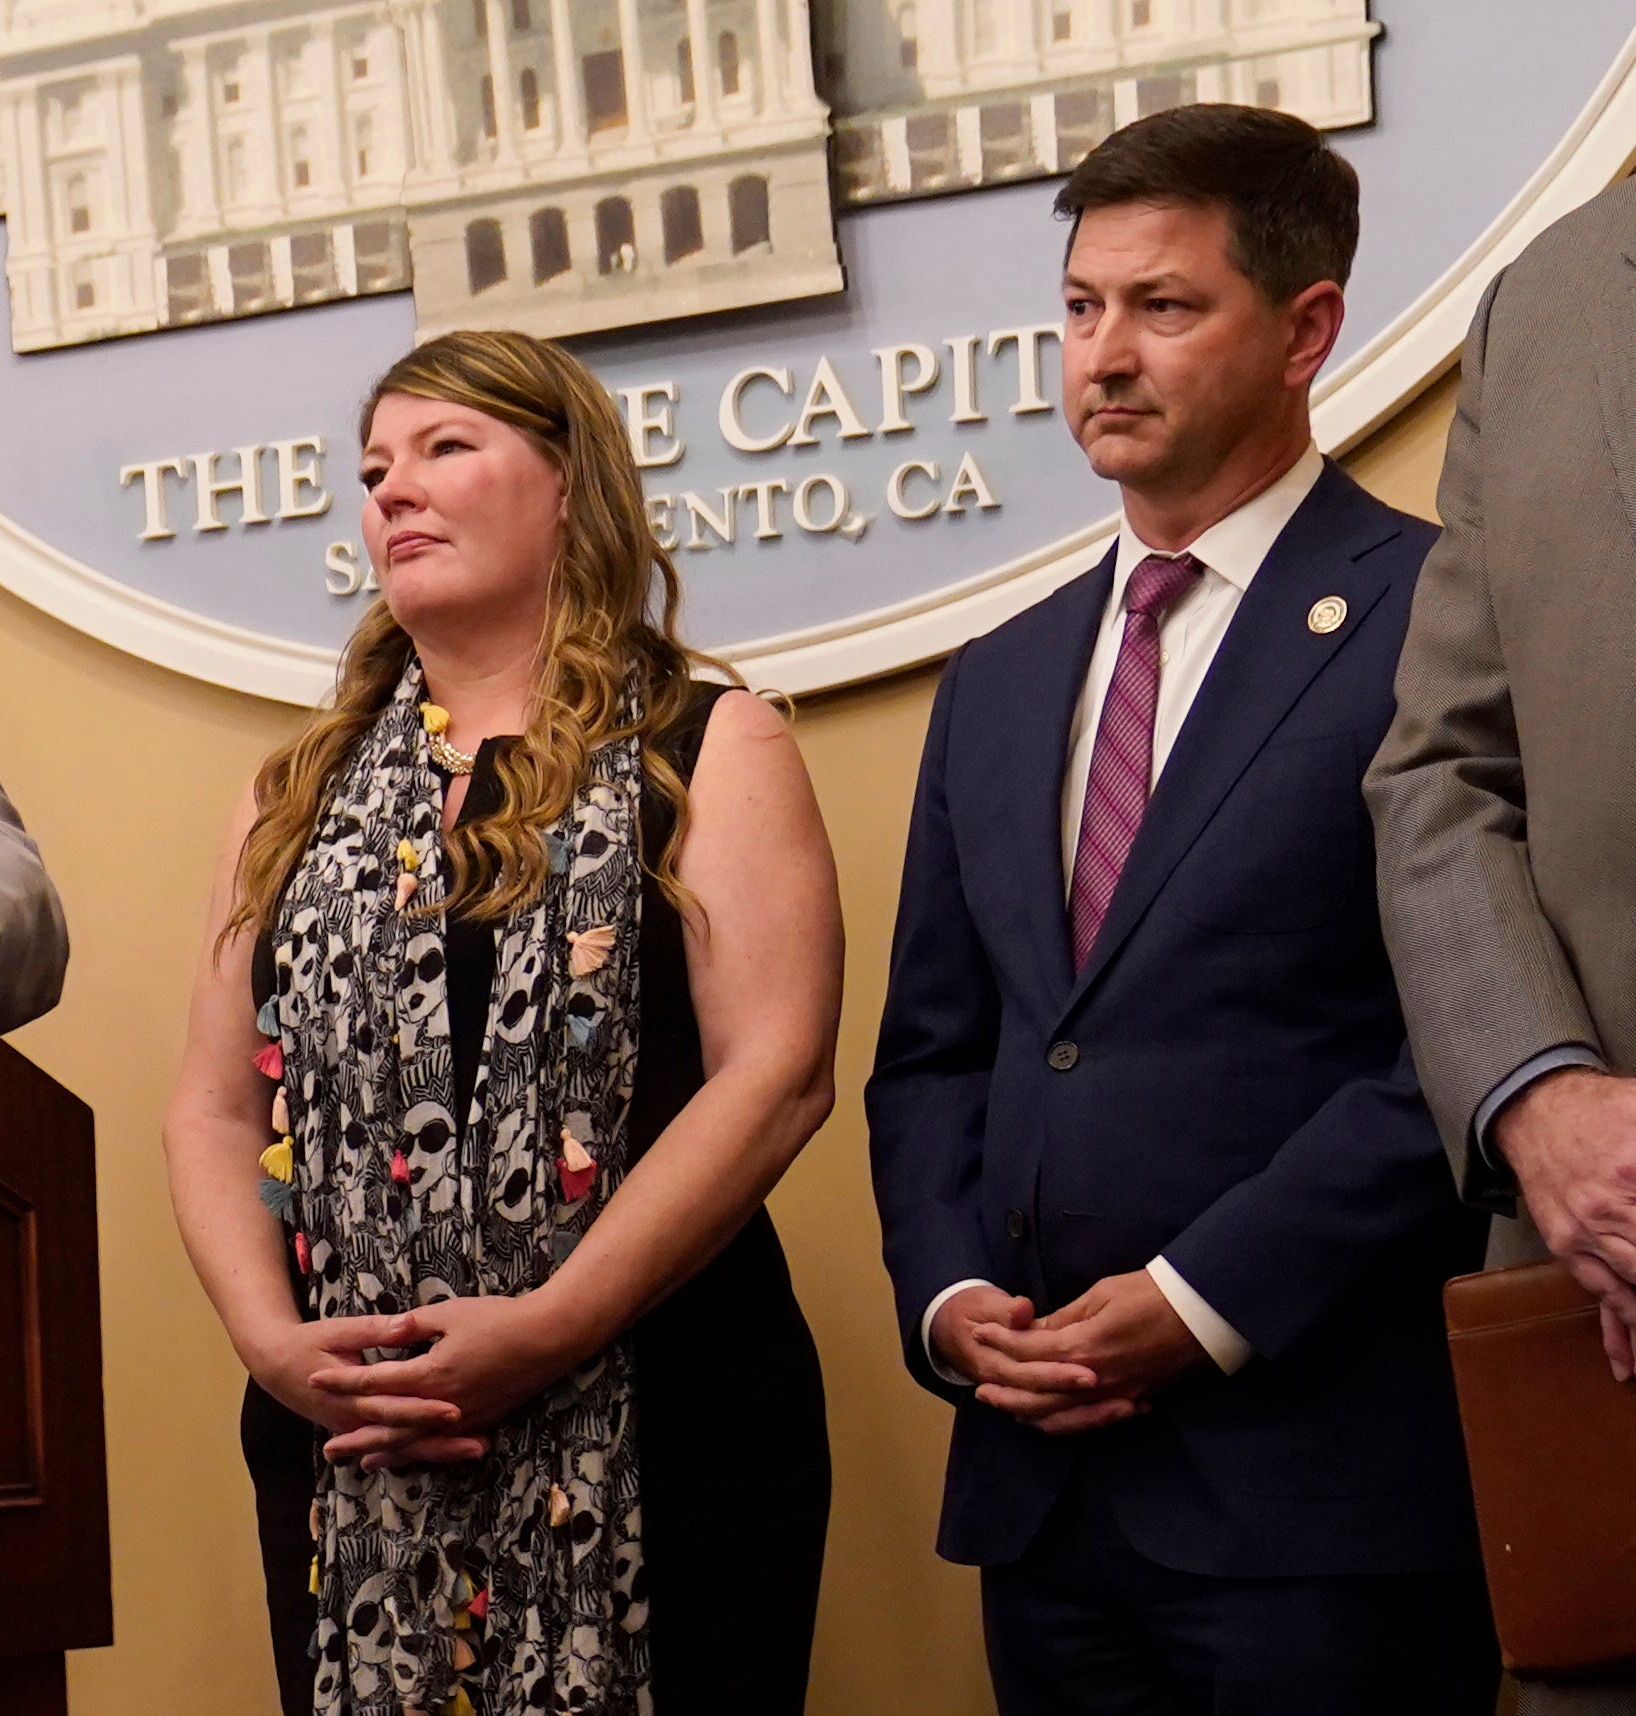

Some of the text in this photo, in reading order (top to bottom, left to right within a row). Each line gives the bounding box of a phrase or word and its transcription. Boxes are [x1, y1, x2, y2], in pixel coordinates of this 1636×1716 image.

[120, 434, 333, 541] THE
[718, 322, 1065, 453] CAPIT
[886, 450, 1002, 519] CA
